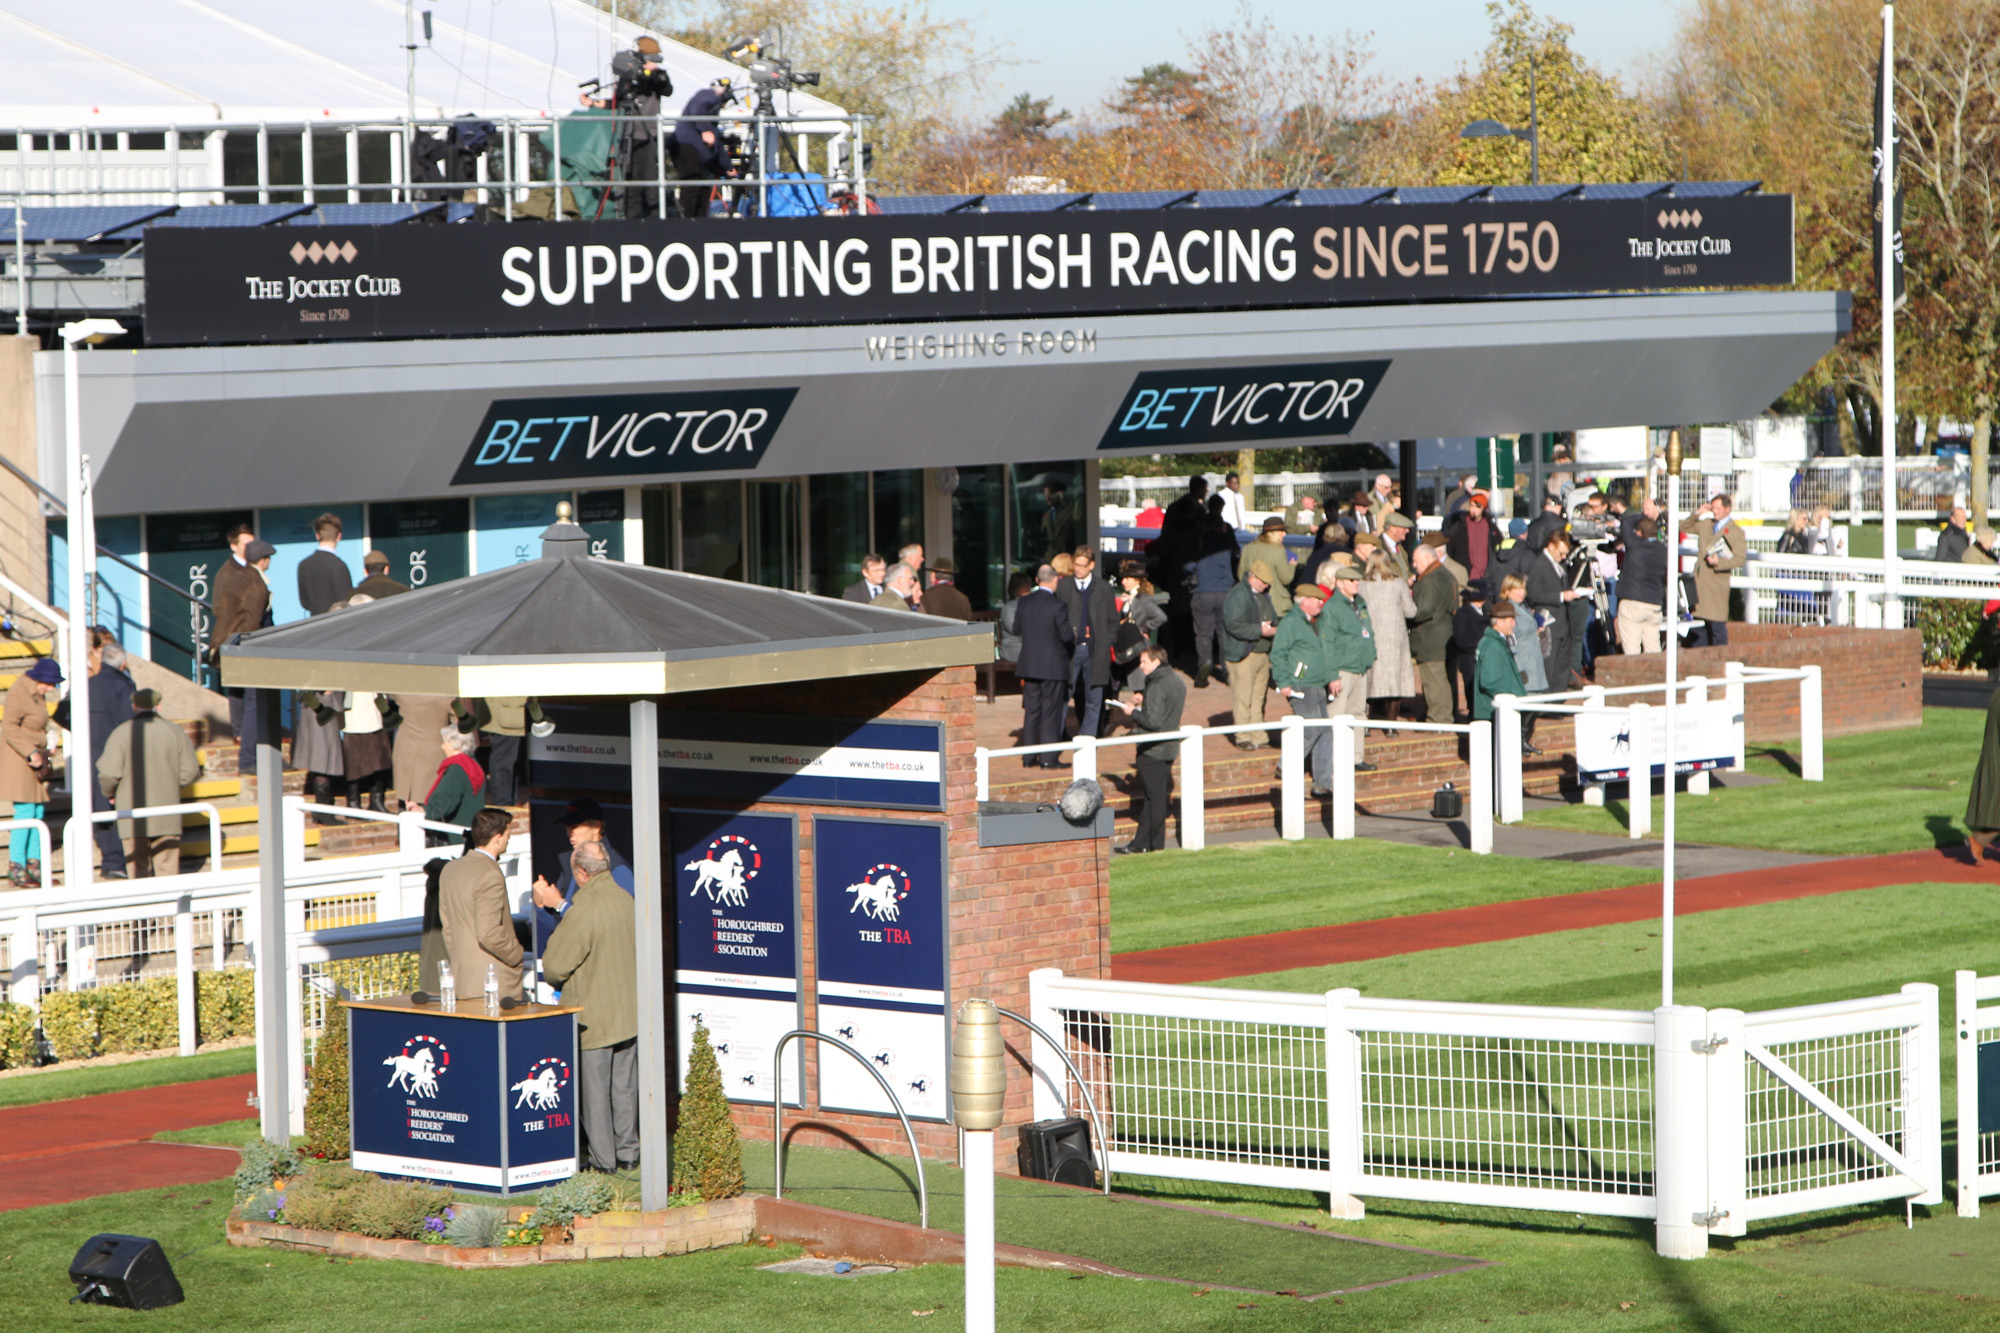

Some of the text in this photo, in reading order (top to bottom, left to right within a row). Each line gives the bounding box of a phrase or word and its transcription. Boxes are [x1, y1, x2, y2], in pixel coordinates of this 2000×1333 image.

[501, 220, 1560, 307] SUPPORTING BRITISH RACING SINCE 1750
[299, 308, 350, 322] Since 1750
[865, 328, 1098, 361] WEIGHING ROOM
[1119, 378, 1365, 432] BETVICTOR
[474, 408, 769, 466] BETVICTOR
[545, 743, 616, 755] www.thetba.co.uk
[658, 749, 714, 760] .thetba.co.uk
[749, 755, 824, 766] www.thetba.co.uk
[849, 760, 925, 771] www.thetba.co.uk
[712, 918, 784, 933] THOROUGHBRED
[859, 928, 912, 944] THE TBA
[713, 944, 768, 957] ASSOCIATION
[407, 1107, 469, 1123] THOROUGHBRED
[523, 1113, 571, 1132] THE TBA
[407, 1131, 455, 1144] ASSOCIATION
[401, 1163, 453, 1176] www.thetba.co.uk
[514, 1165, 569, 1180] www.thetba.co.uk
